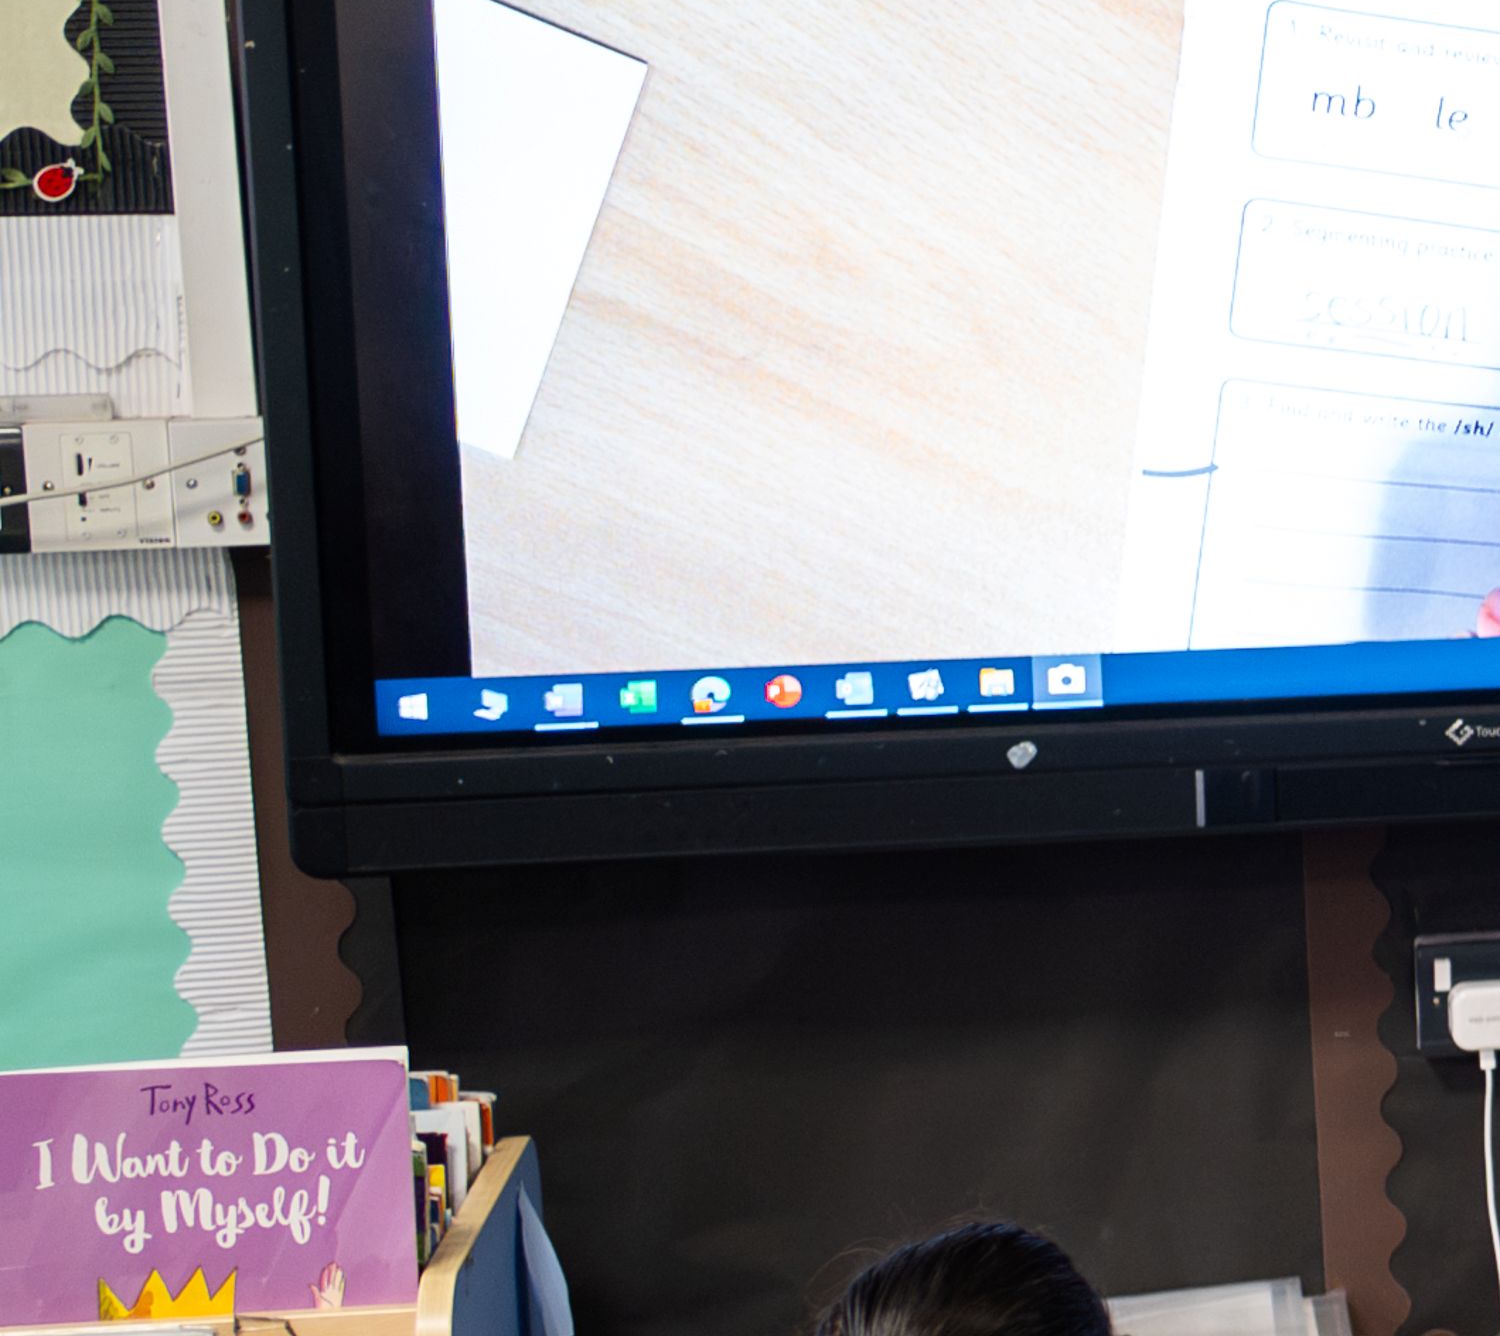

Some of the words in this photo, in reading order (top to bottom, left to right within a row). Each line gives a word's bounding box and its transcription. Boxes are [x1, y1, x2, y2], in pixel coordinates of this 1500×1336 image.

[1310, 84, 1378, 121] mb
[1433, 95, 1470, 132] le
[1417, 416, 1448, 434] the
[1452, 418, 1494, 440] /sh/
[139, 1082, 198, 1126] Tony
[202, 1081, 259, 1118] Ross
[32, 1138, 58, 1192] I
[70, 1132, 190, 1190] Want
[196, 1138, 244, 1179] to
[252, 1131, 318, 1177] Do
[325, 1131, 366, 1173] it
[93, 1194, 154, 1255] by
[160, 1175, 333, 1252] Myself!
